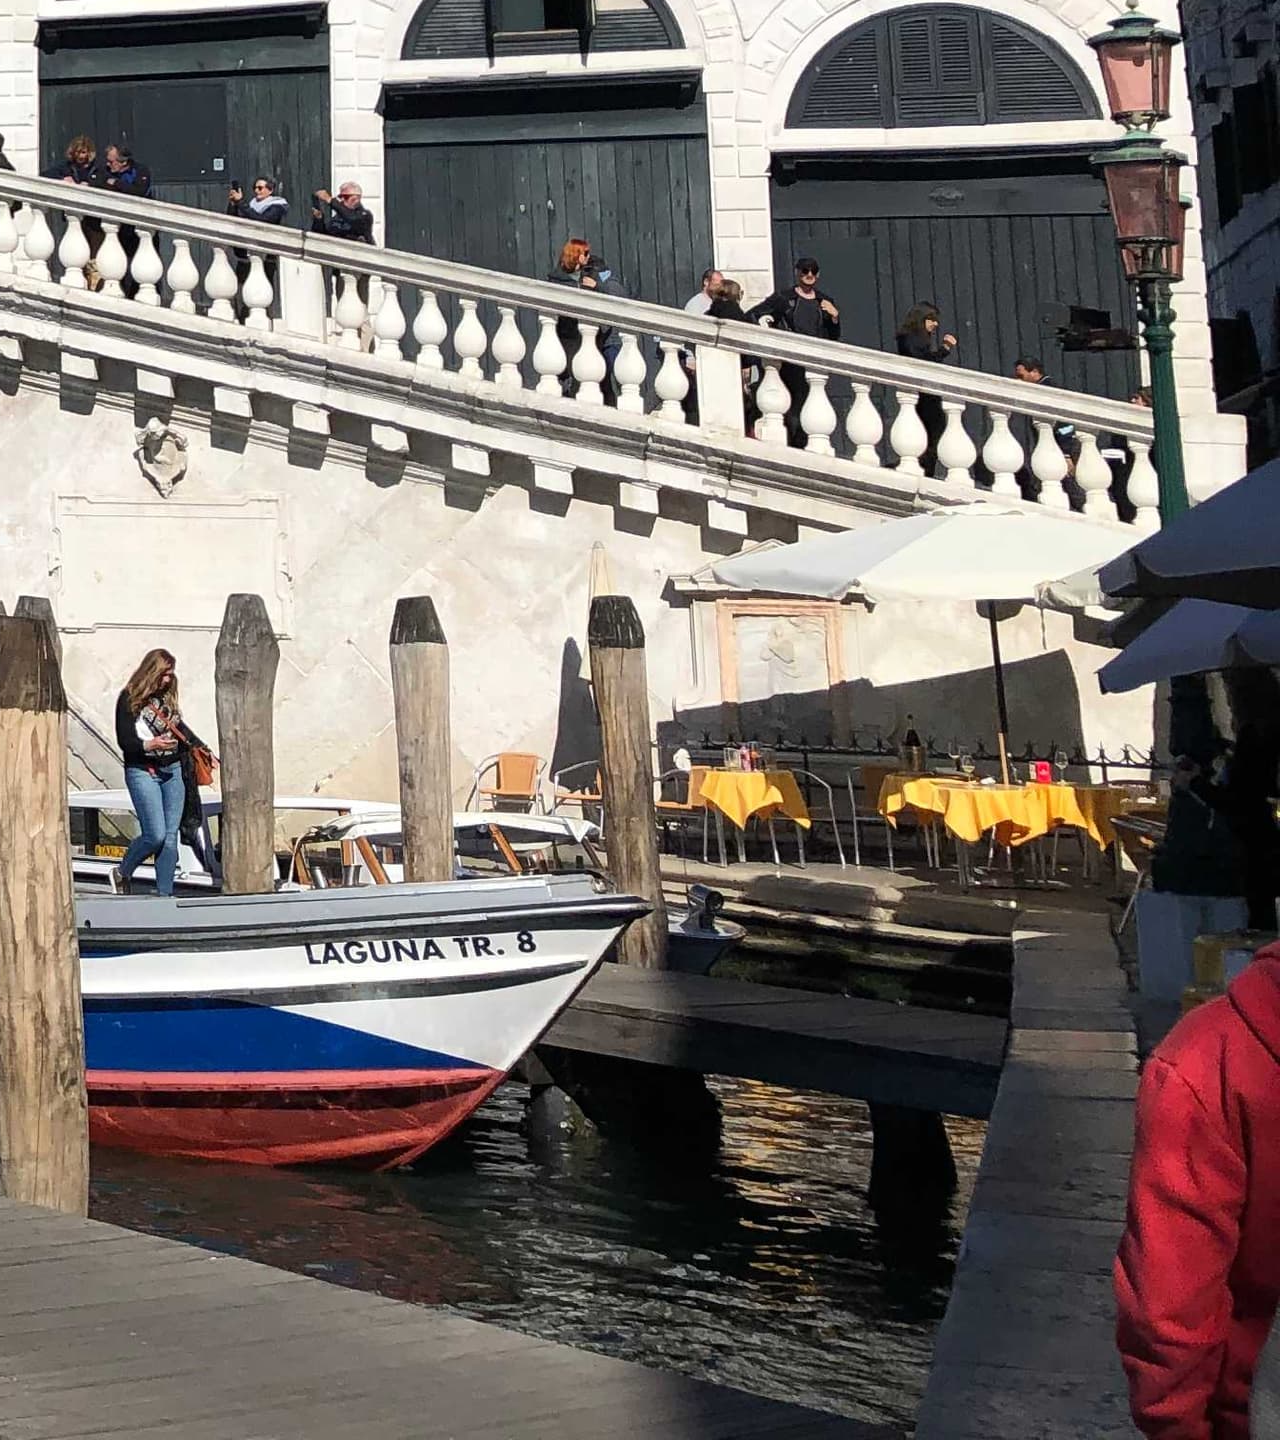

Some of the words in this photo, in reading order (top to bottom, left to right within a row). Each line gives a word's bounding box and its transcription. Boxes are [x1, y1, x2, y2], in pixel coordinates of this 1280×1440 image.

[304, 938, 446, 965] LAGUNA
[453, 935, 506, 959] TR.
[516, 929, 537, 954] 8
